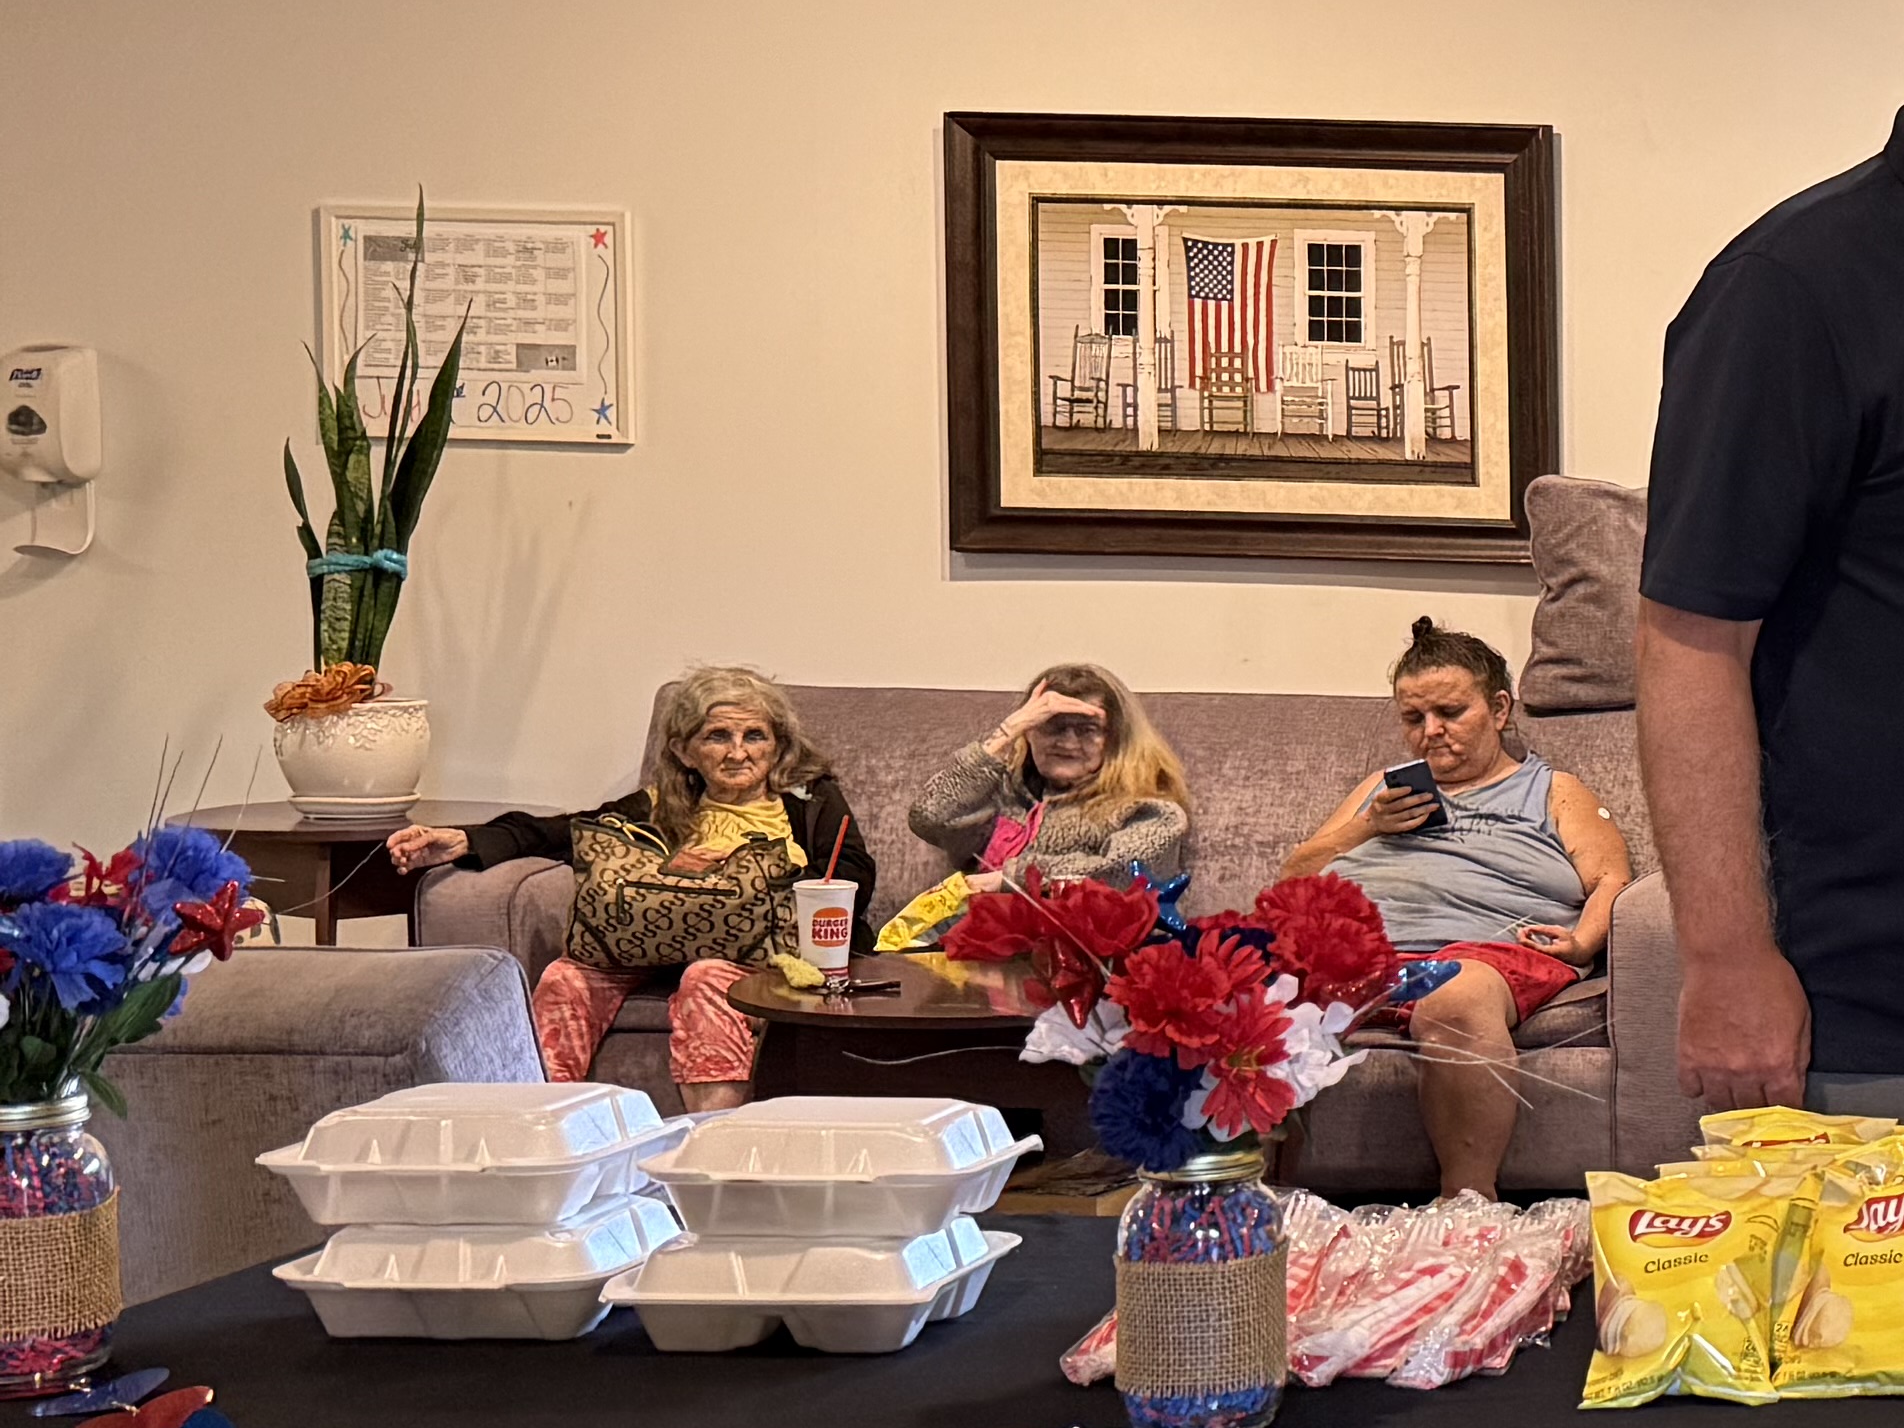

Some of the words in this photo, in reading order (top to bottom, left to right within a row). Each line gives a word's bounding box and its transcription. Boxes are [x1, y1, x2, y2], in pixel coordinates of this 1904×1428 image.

[477, 380, 574, 425] 2025
[812, 928, 848, 939] KING
[1634, 1211, 1728, 1238] Lay's
[1643, 1252, 1710, 1274] Classic
[1843, 1249, 1904, 1267] Classic
